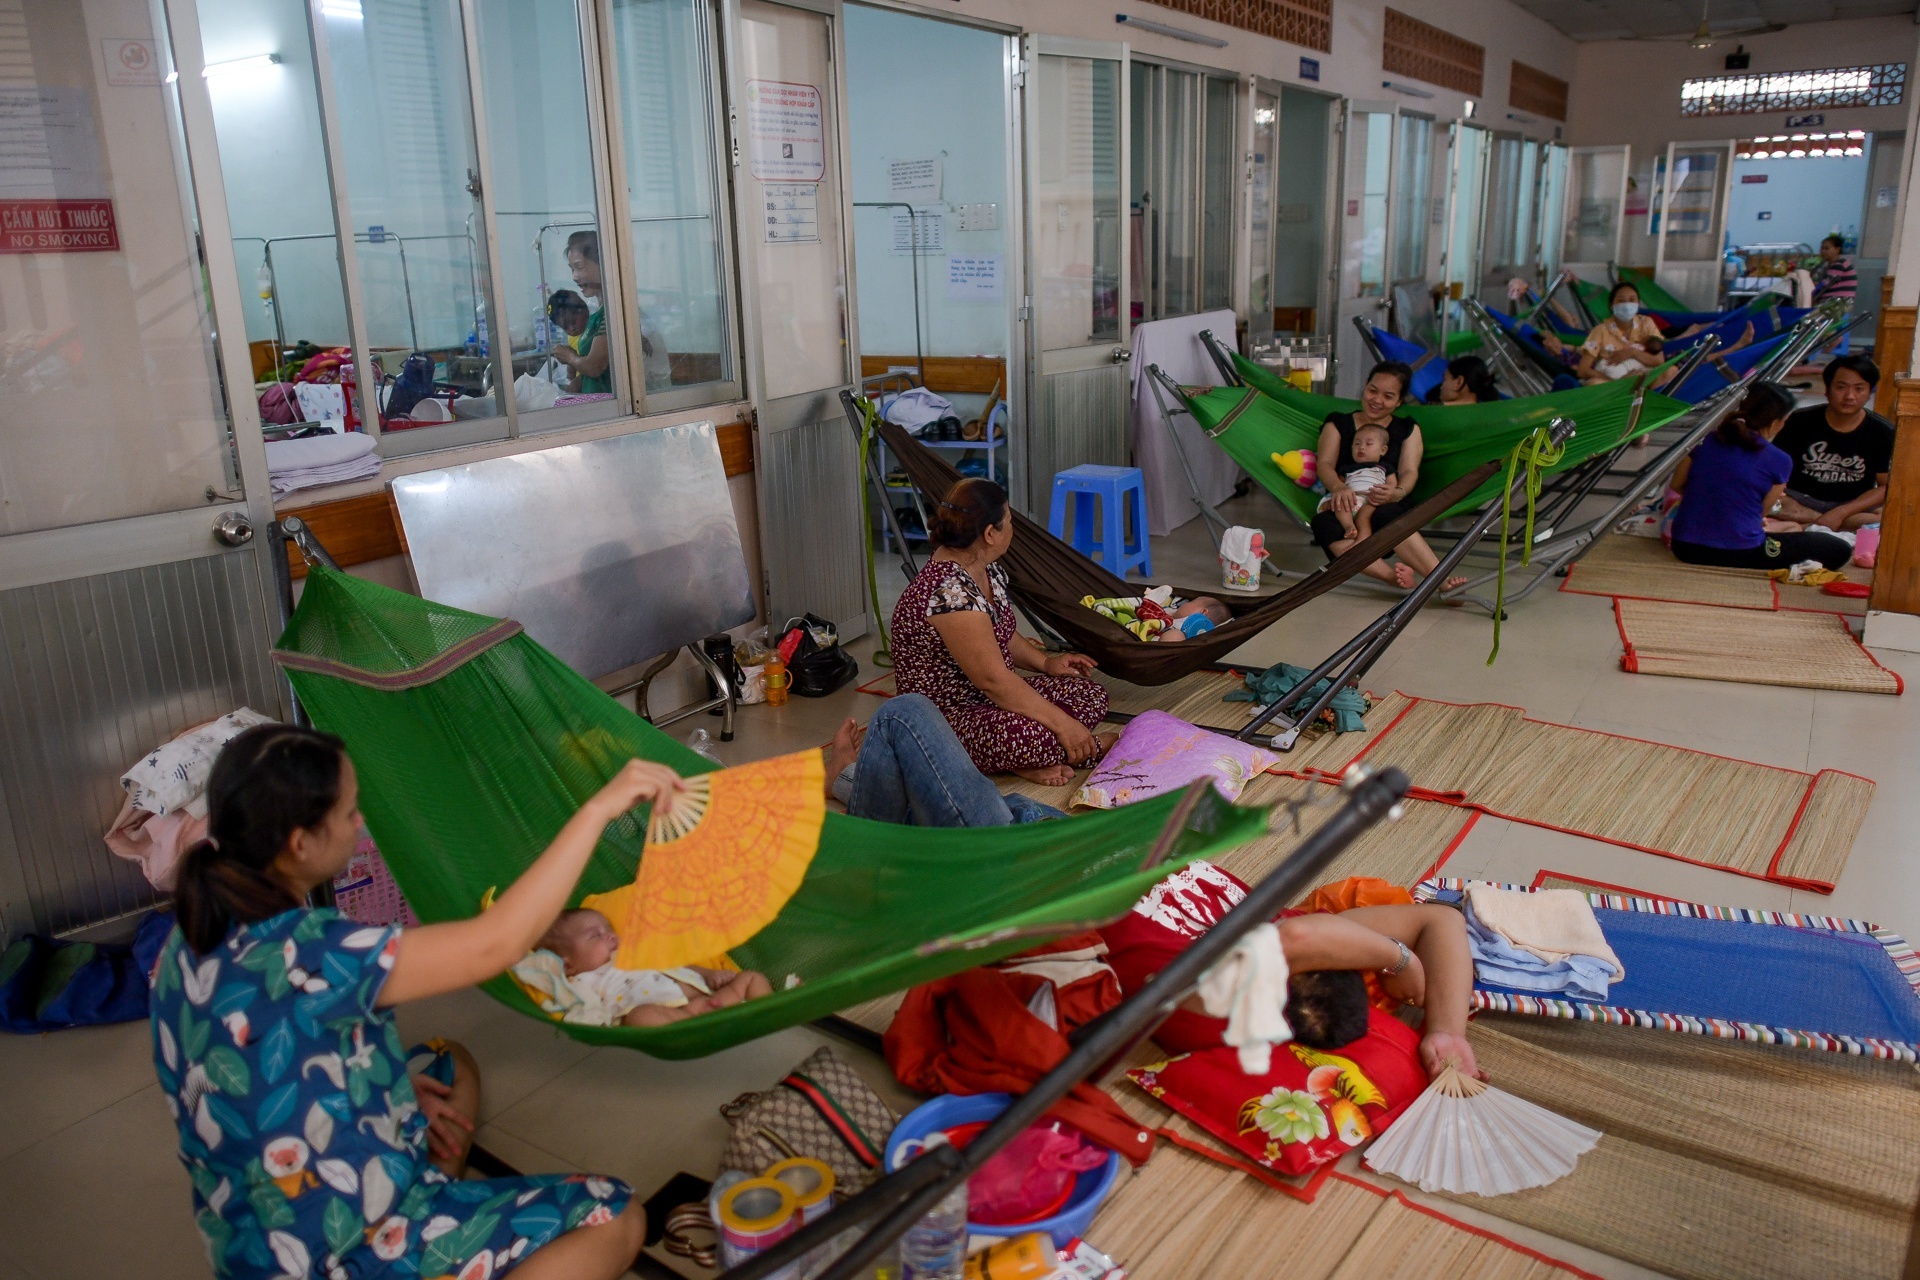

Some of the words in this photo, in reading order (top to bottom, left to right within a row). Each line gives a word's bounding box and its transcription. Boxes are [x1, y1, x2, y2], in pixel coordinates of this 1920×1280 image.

[3, 204, 34, 229] CẤM
[37, 206, 62, 228] HÚT
[66, 204, 108, 227] THUỐC
[10, 235, 34, 247] NO
[39, 233, 110, 246] SMOKING
[1802, 441, 1866, 473] Super
